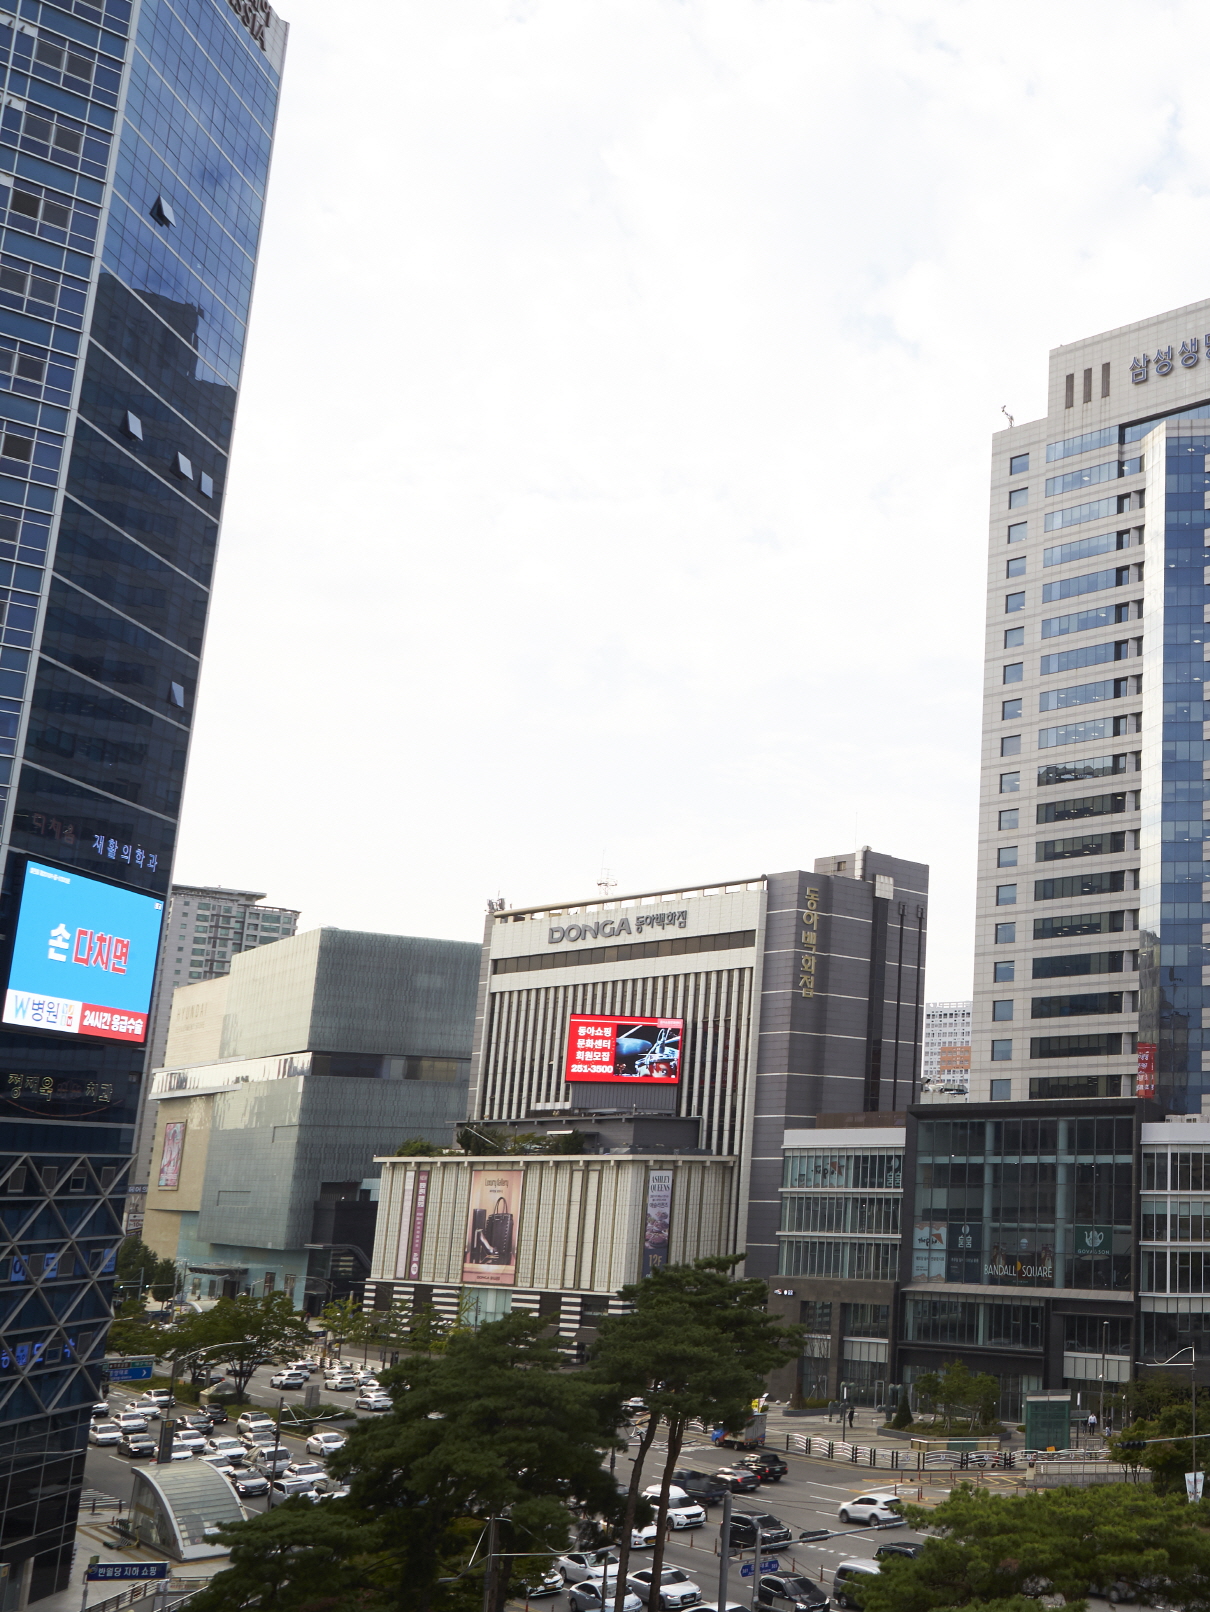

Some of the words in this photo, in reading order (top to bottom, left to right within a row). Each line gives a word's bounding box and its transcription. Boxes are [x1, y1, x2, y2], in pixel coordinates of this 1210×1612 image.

[92, 834, 158, 873] 재활의학과
[548, 917, 632, 944] DONGA
[635, 910, 688, 934] 동아백화점
[799, 887, 819, 998] 동아백화점
[47, 923, 72, 963] 손
[72, 927, 131, 975] 다치면
[15, 995, 60, 1024] W병원
[83, 1010, 111, 1030] 24시간
[111, 1016, 144, 1035] 응급수술
[577, 1026, 612, 1037] 동아쇼핑
[576, 1039, 611, 1050] 문화센터
[575, 1051, 611, 1062] 회원모집
[570, 1064, 614, 1073] 251-3500
[652, 1175, 670, 1184] ASHLEY
[650, 1184, 670, 1193] QUEENS
[984, 1264, 1017, 1277] BANDALL
[1021, 1265, 1053, 1278] SQUARE
[98, 1567, 122, 1577] 반월당
[123, 1567, 140, 1576] 지하
[141, 1566, 157, 1576] 쇼핑
